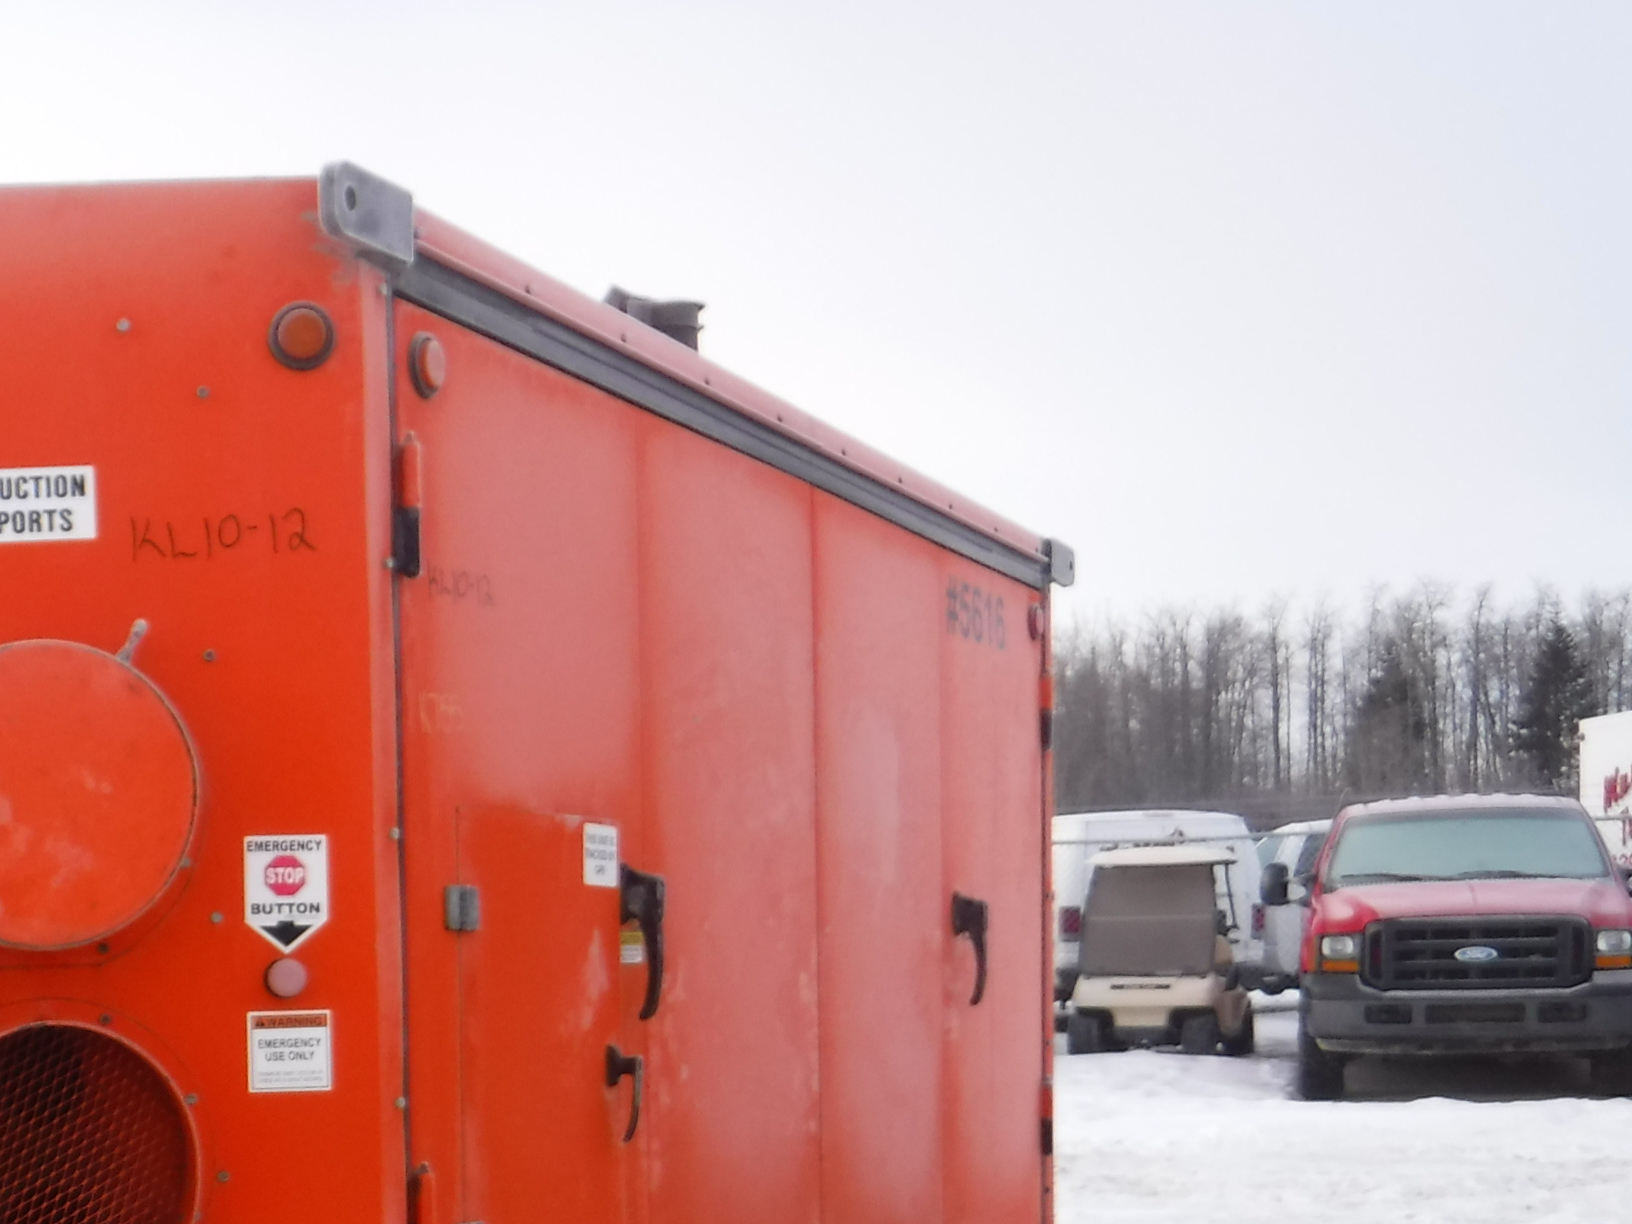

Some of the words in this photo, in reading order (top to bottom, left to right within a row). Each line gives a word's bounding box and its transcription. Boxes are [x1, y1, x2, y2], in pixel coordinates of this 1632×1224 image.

[246, 840, 322, 852] EMERGENCY
[266, 866, 305, 884] STOP
[250, 902, 320, 915] BUTTON
[267, 1016, 322, 1028] WARNING
[257, 1037, 321, 1049] EMERGENCY
[265, 1051, 286, 1062] USE
[288, 1050, 314, 1061] ONLY
